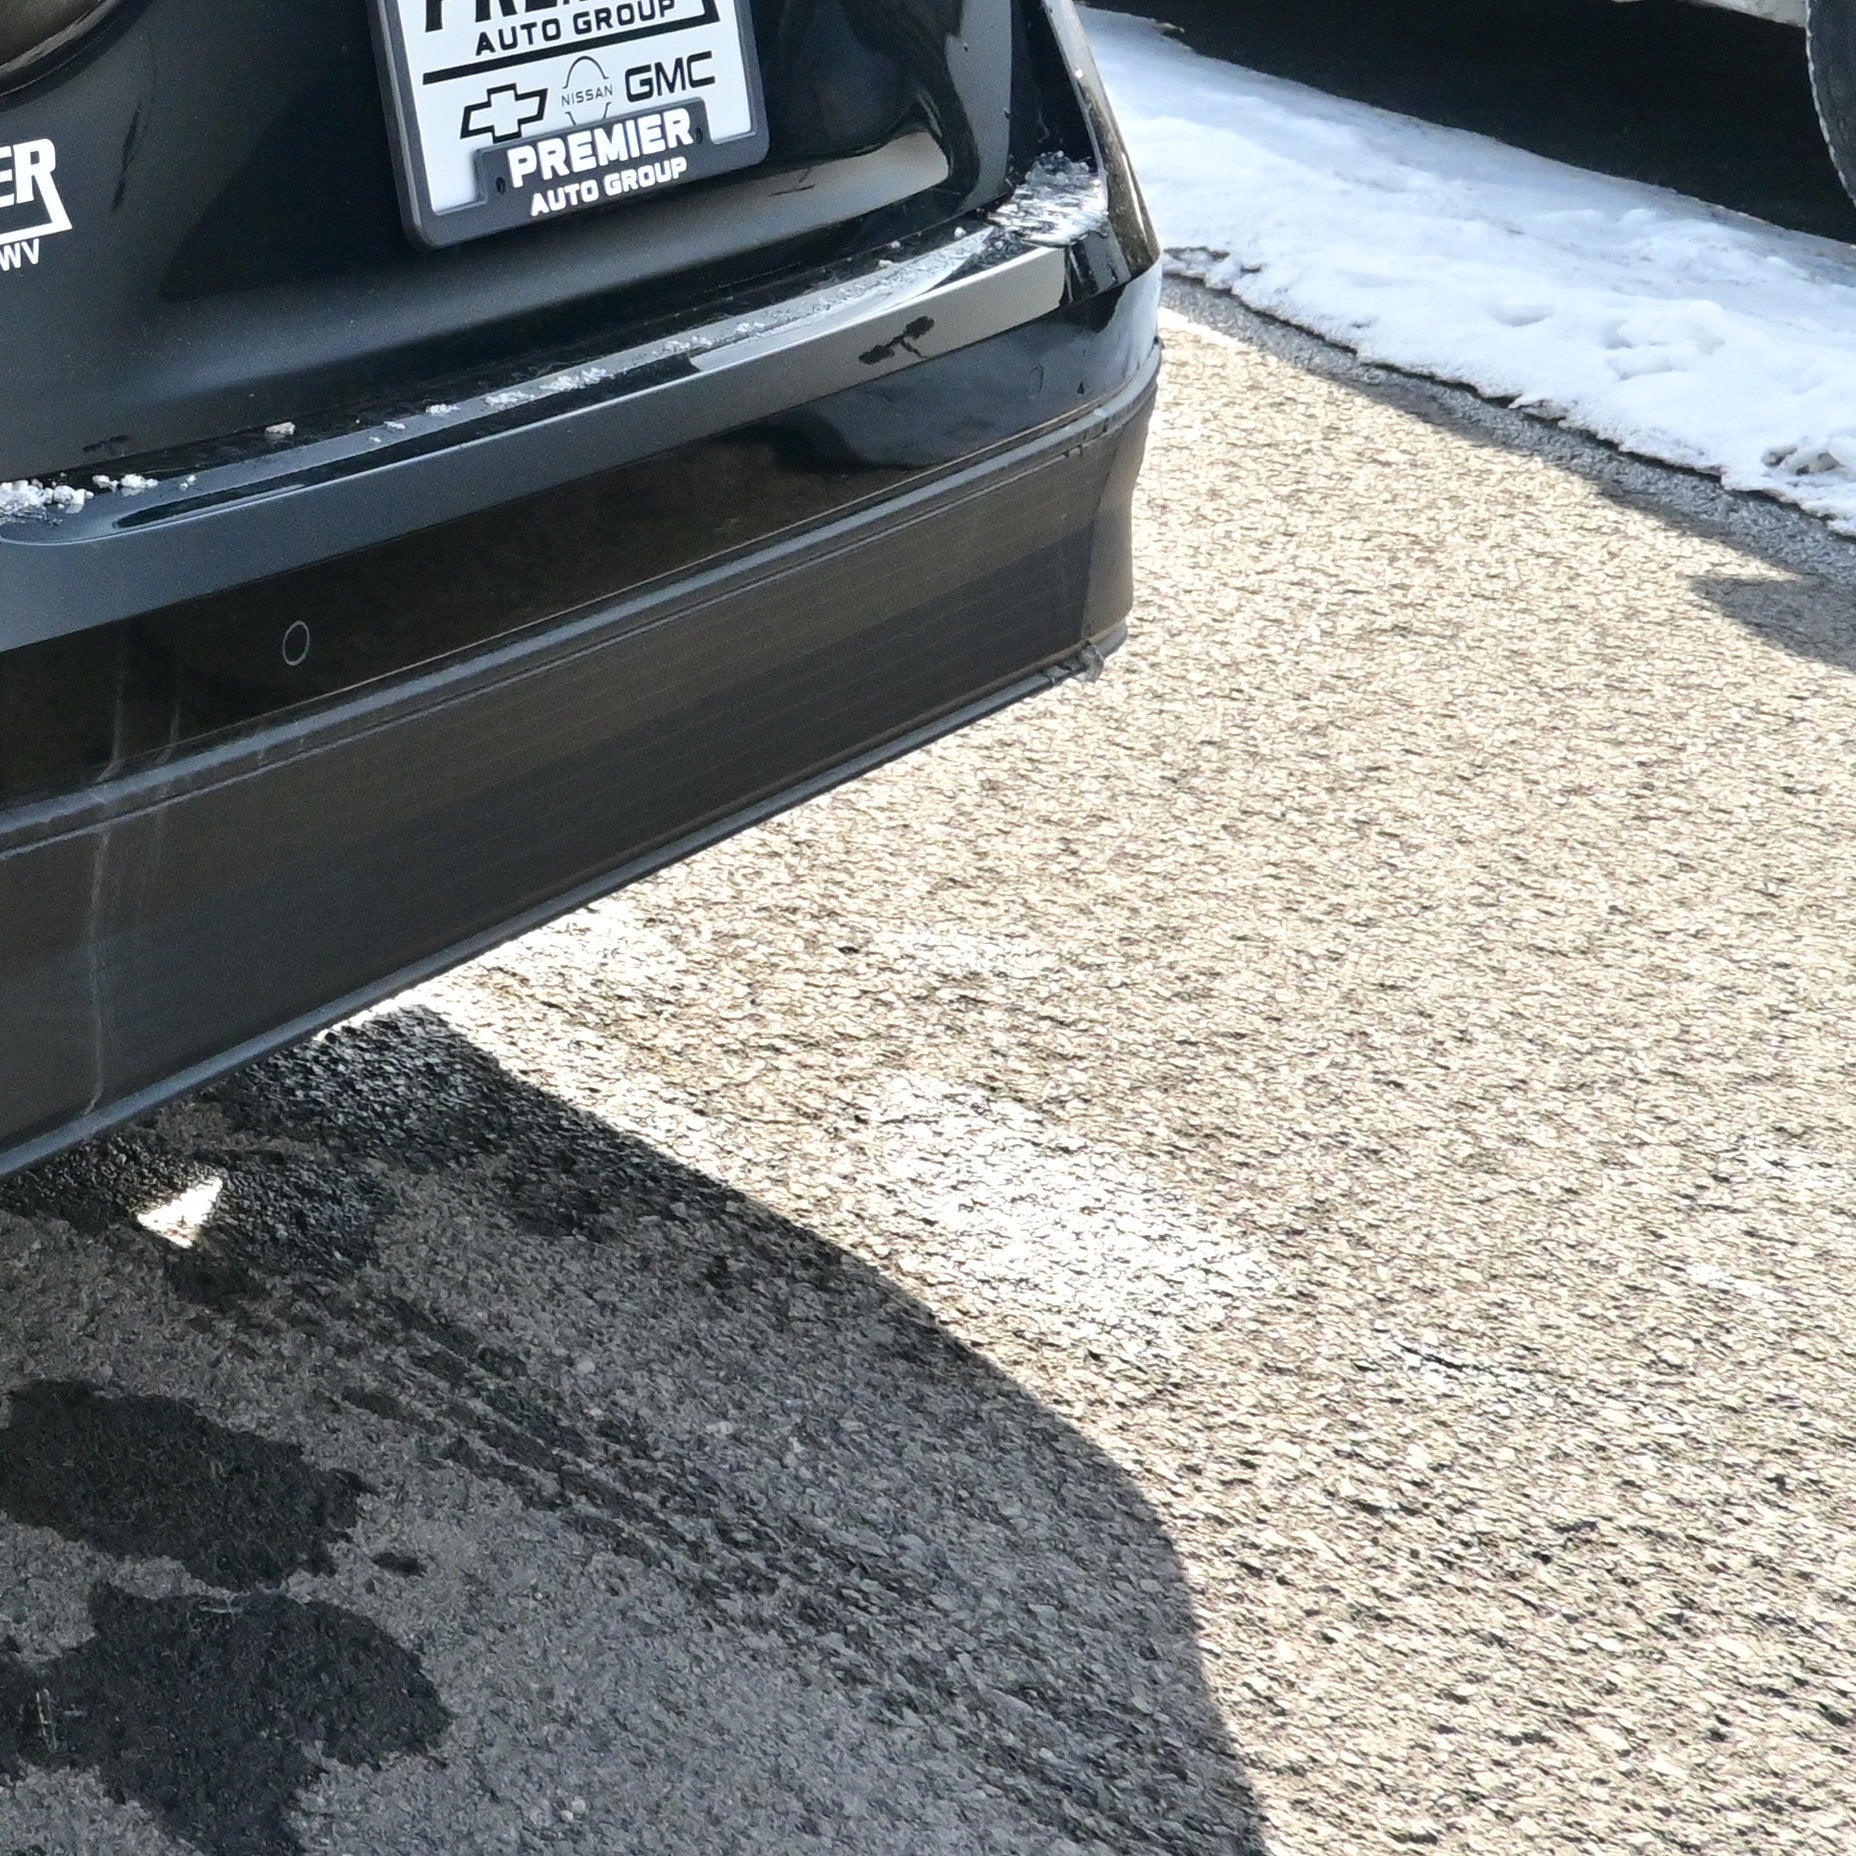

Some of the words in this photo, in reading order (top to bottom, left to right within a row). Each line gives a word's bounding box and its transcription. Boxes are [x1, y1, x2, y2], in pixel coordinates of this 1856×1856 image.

[475, 18, 561, 57] AUTO
[561, 84, 614, 108] NISSAN
[624, 51, 716, 104] GMC
[507, 108, 694, 188] PREMIER
[530, 177, 599, 216] AUTO
[604, 156, 687, 197] GROUP
